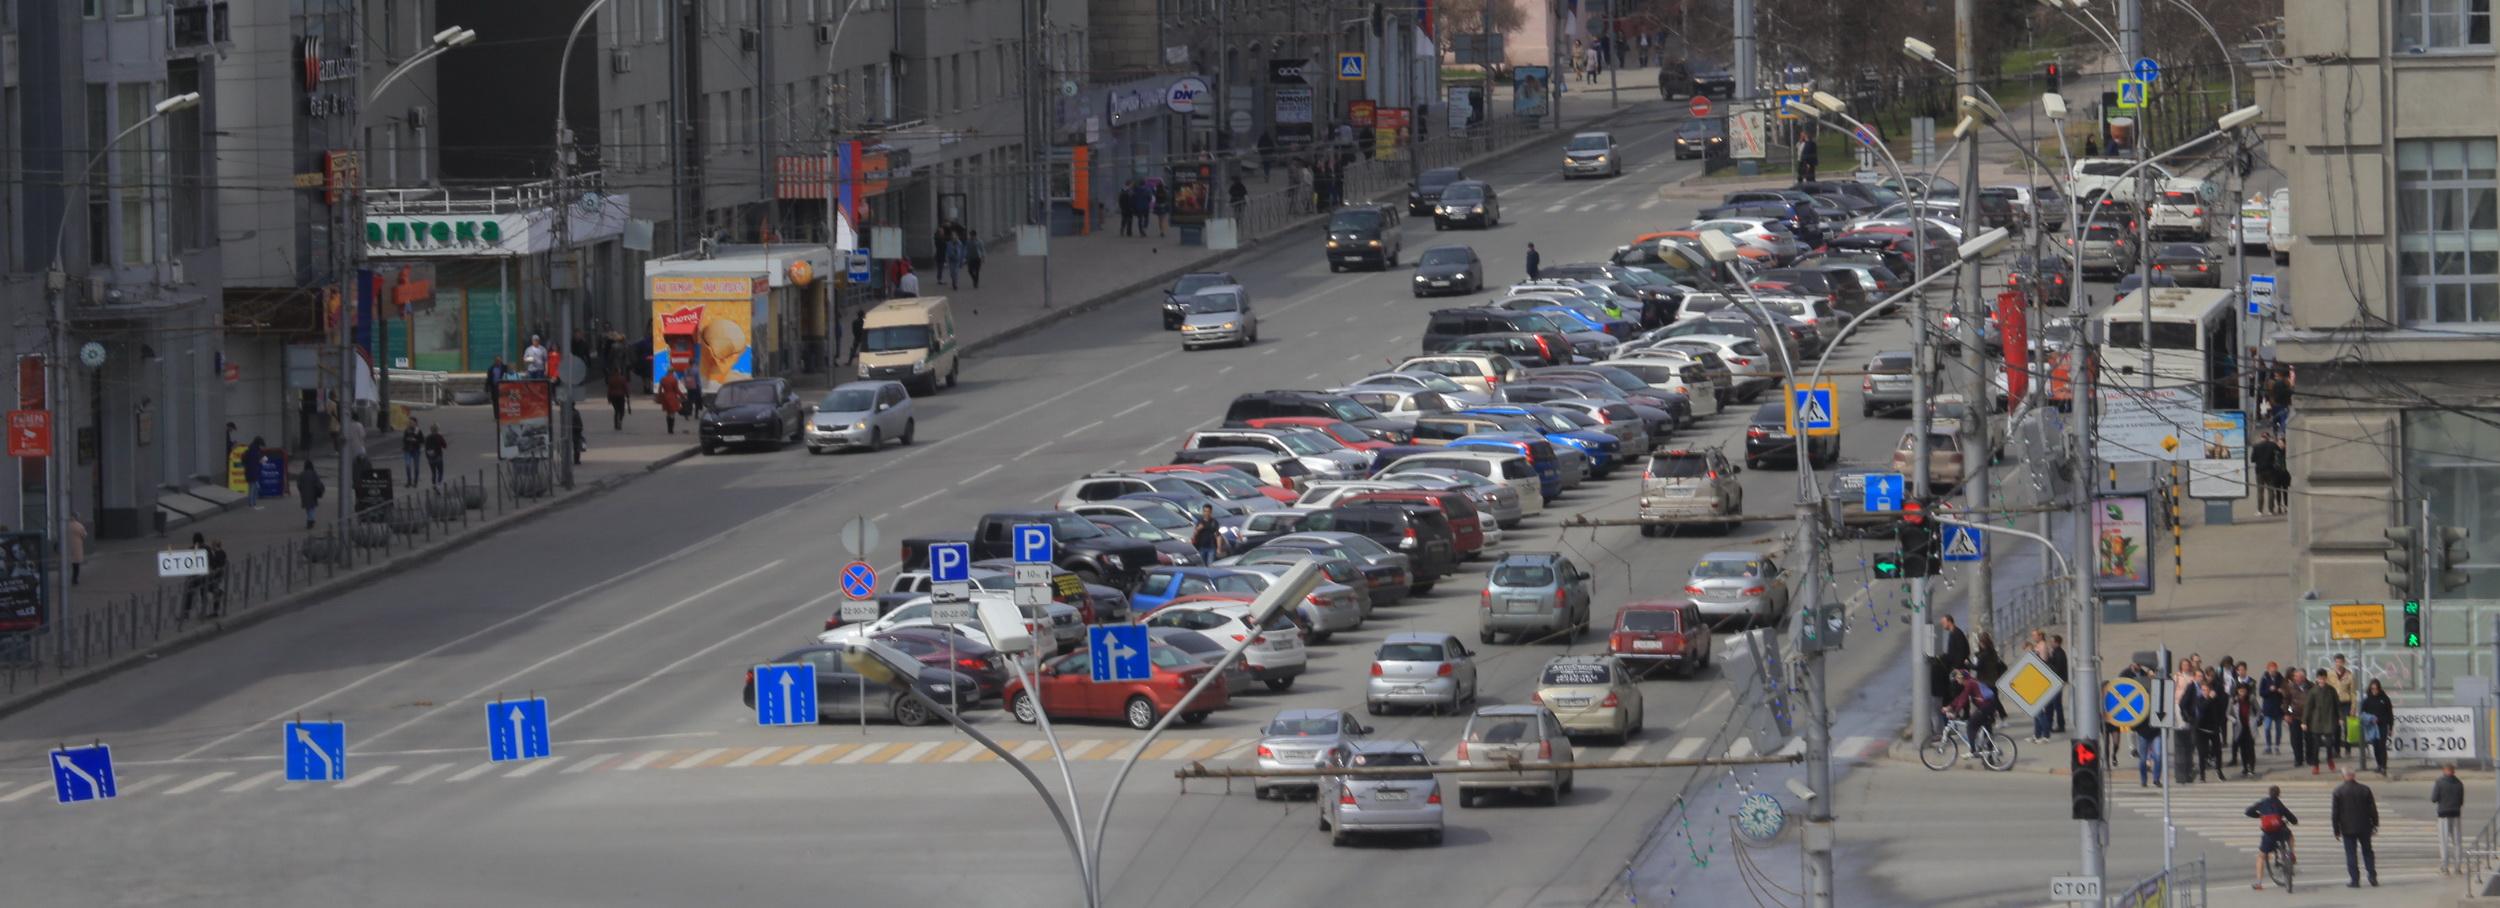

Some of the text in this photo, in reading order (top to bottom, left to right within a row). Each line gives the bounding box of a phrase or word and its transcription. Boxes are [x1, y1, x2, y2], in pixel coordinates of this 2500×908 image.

[1024, 529, 1046, 561] P
[162, 556, 205, 570] СТОП
[939, 548, 960, 580] P
[2392, 714, 2470, 723] РОФЕССИОНАЛ
[2053, 882, 2098, 896] СТОП
